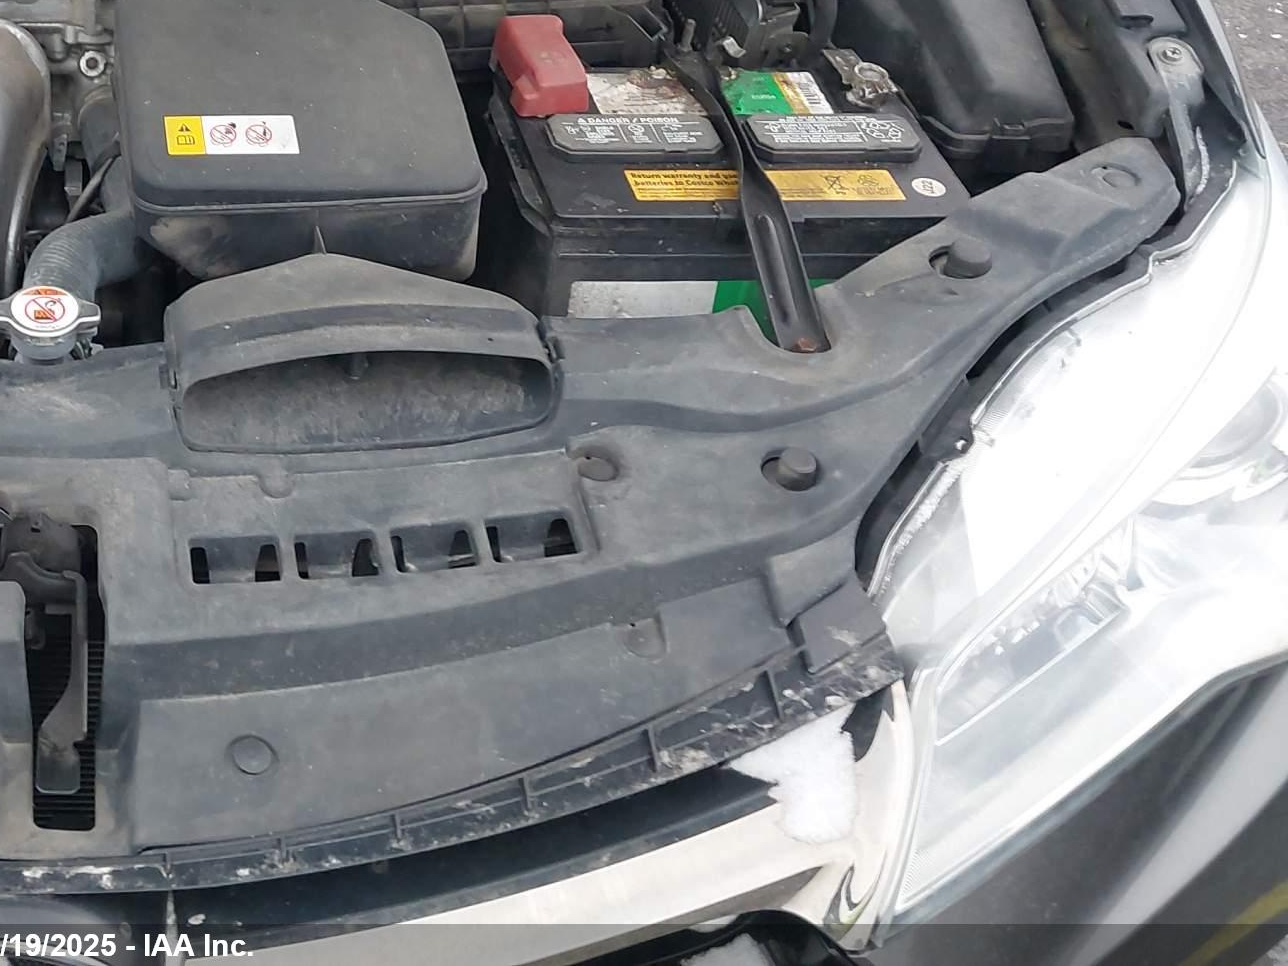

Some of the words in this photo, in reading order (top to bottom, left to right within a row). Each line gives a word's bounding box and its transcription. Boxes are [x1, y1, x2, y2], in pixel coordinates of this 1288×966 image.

[630, 172, 662, 180] Return
[662, 172, 702, 180] warranty
[703, 172, 721, 180] and
